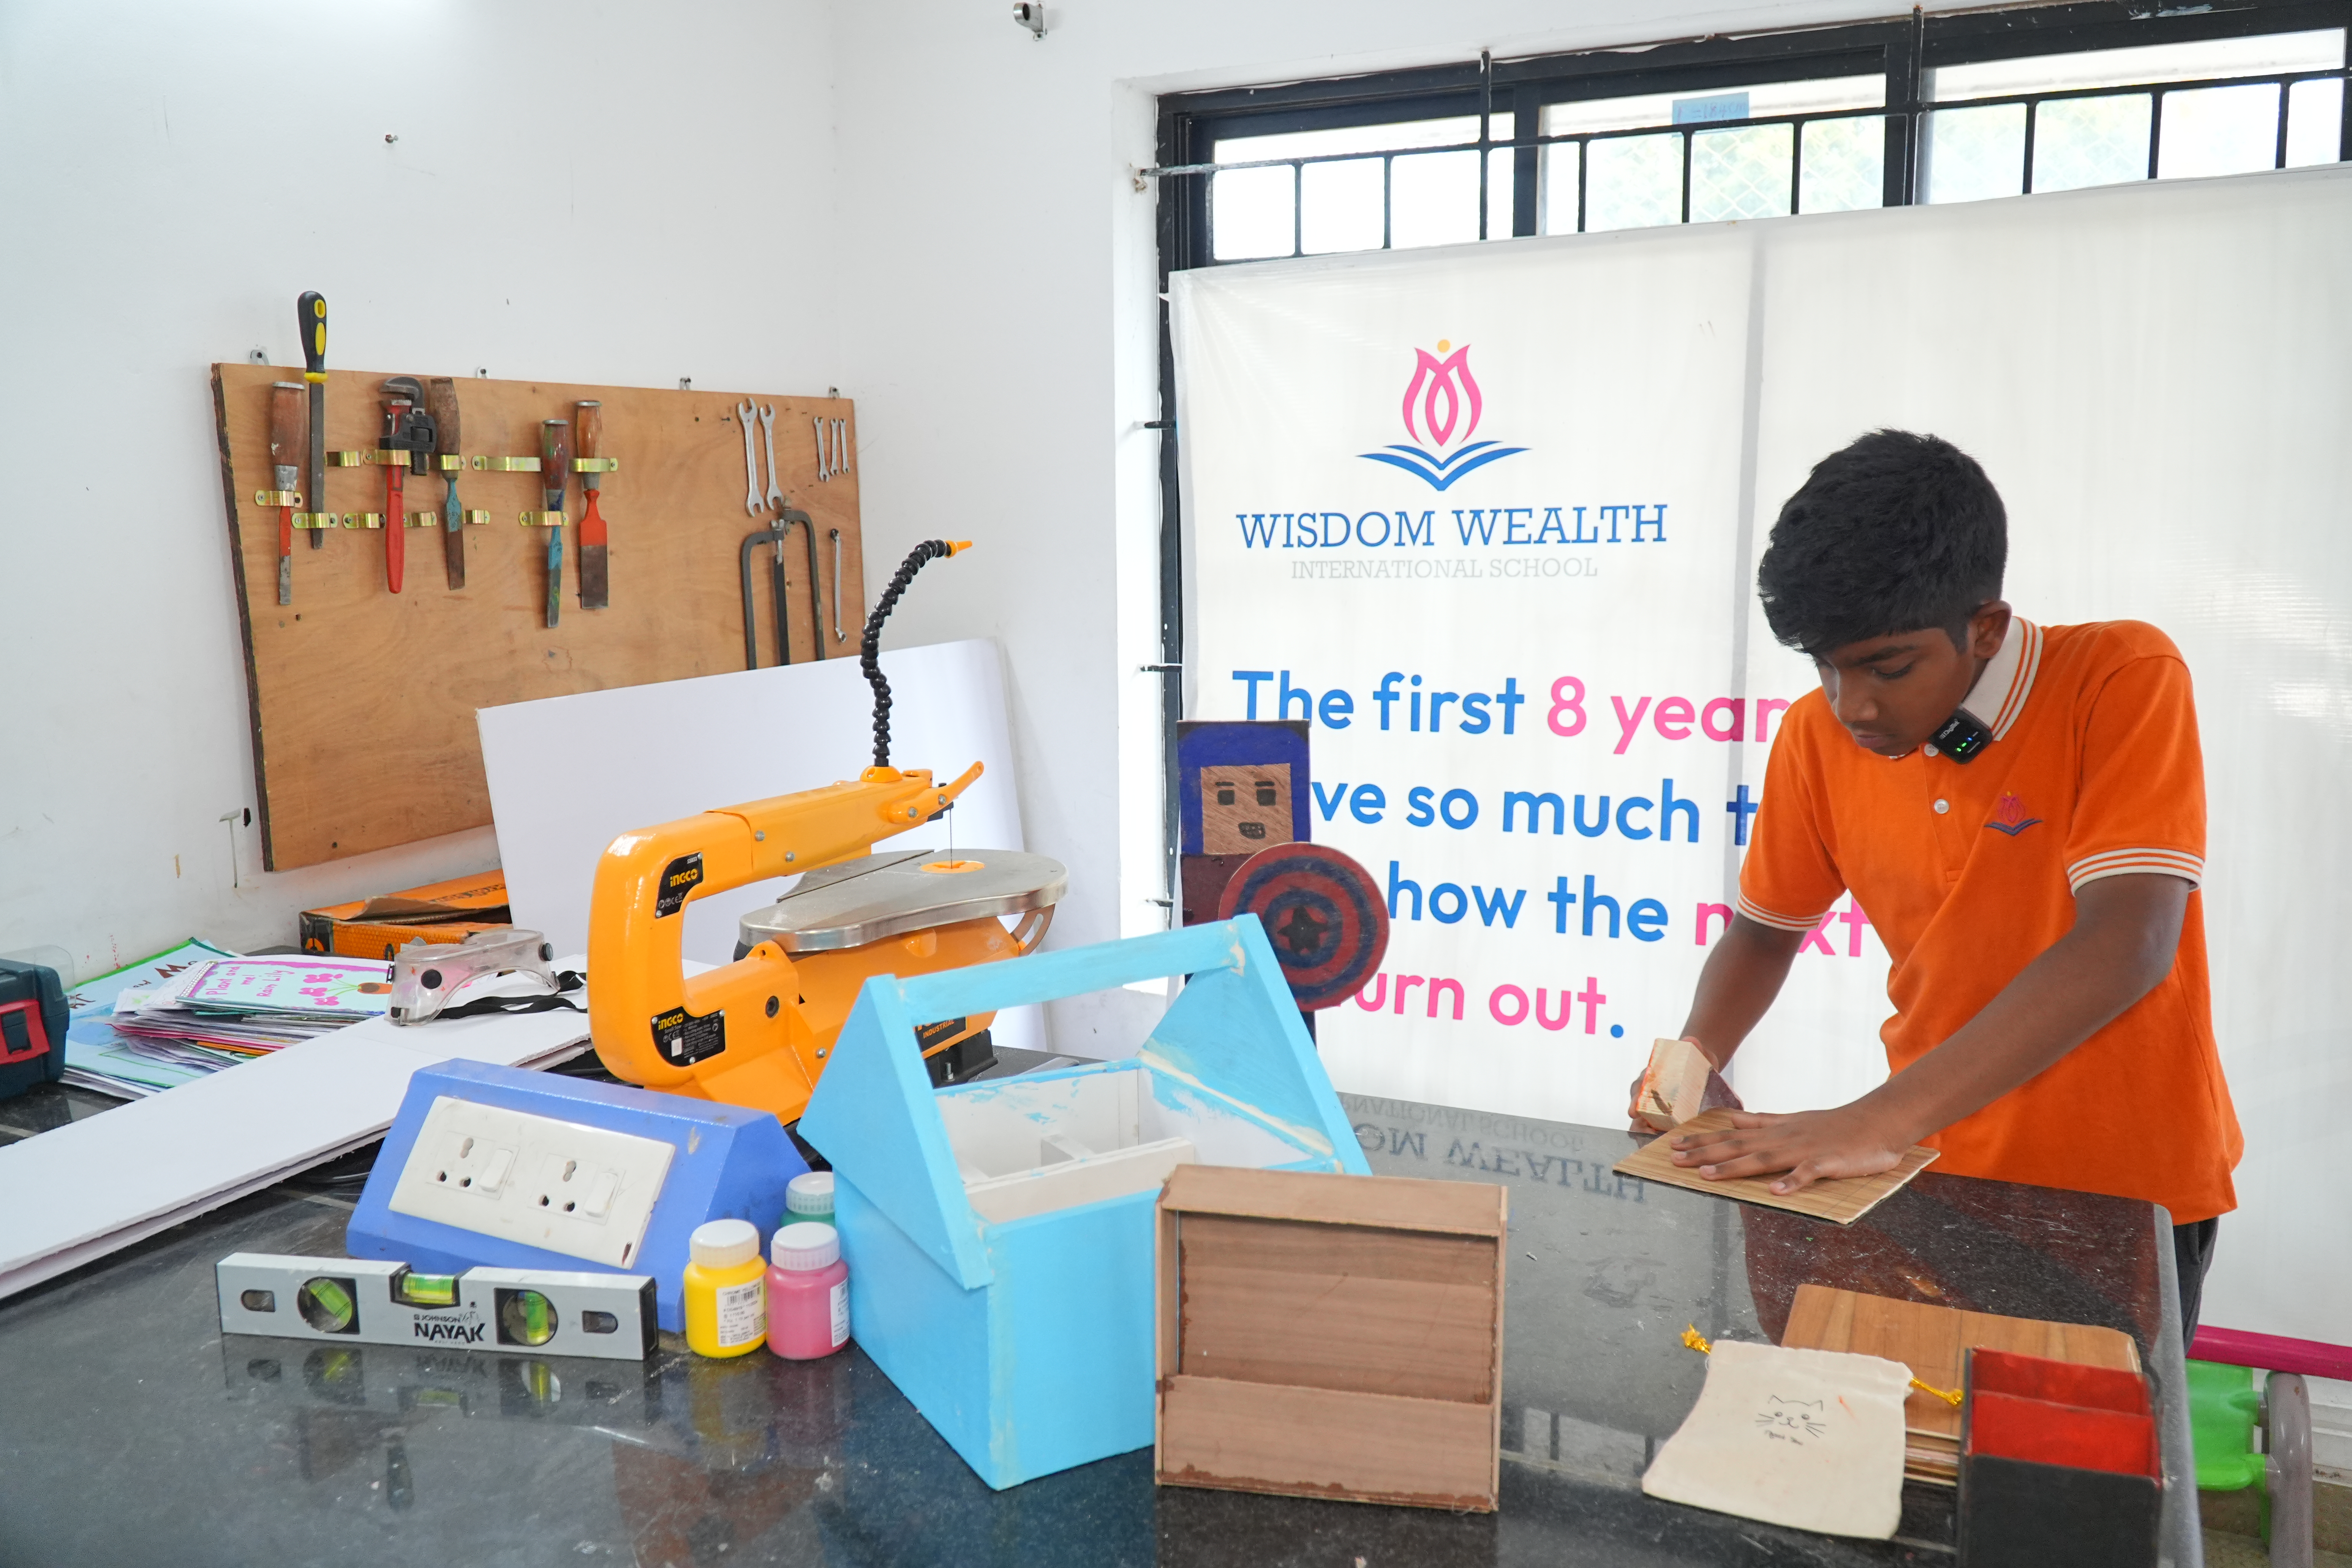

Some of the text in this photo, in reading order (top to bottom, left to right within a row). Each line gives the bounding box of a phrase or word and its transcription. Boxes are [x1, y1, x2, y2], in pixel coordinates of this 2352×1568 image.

[1236, 504, 1668, 548] WISDOM WEALTH
[1291, 557, 1598, 580] INTERNATIONAL SCHOOL
[1232, 670, 1354, 730] The
[1373, 671, 1525, 735] first
[1547, 676, 1587, 737] 8
[1312, 778, 1759, 846] ve so much t
[1387, 860, 1871, 957] how the nxt
[205, 966, 241, 995] Plant and
[256, 970, 295, 997] Rain Lily
[1338, 973, 1624, 1038] urn out.
[923, 1020, 955, 1039] INDUSTRIAL
[414, 1322, 486, 1344] NAYAK
[422, 1314, 461, 1323] JOHNSON
